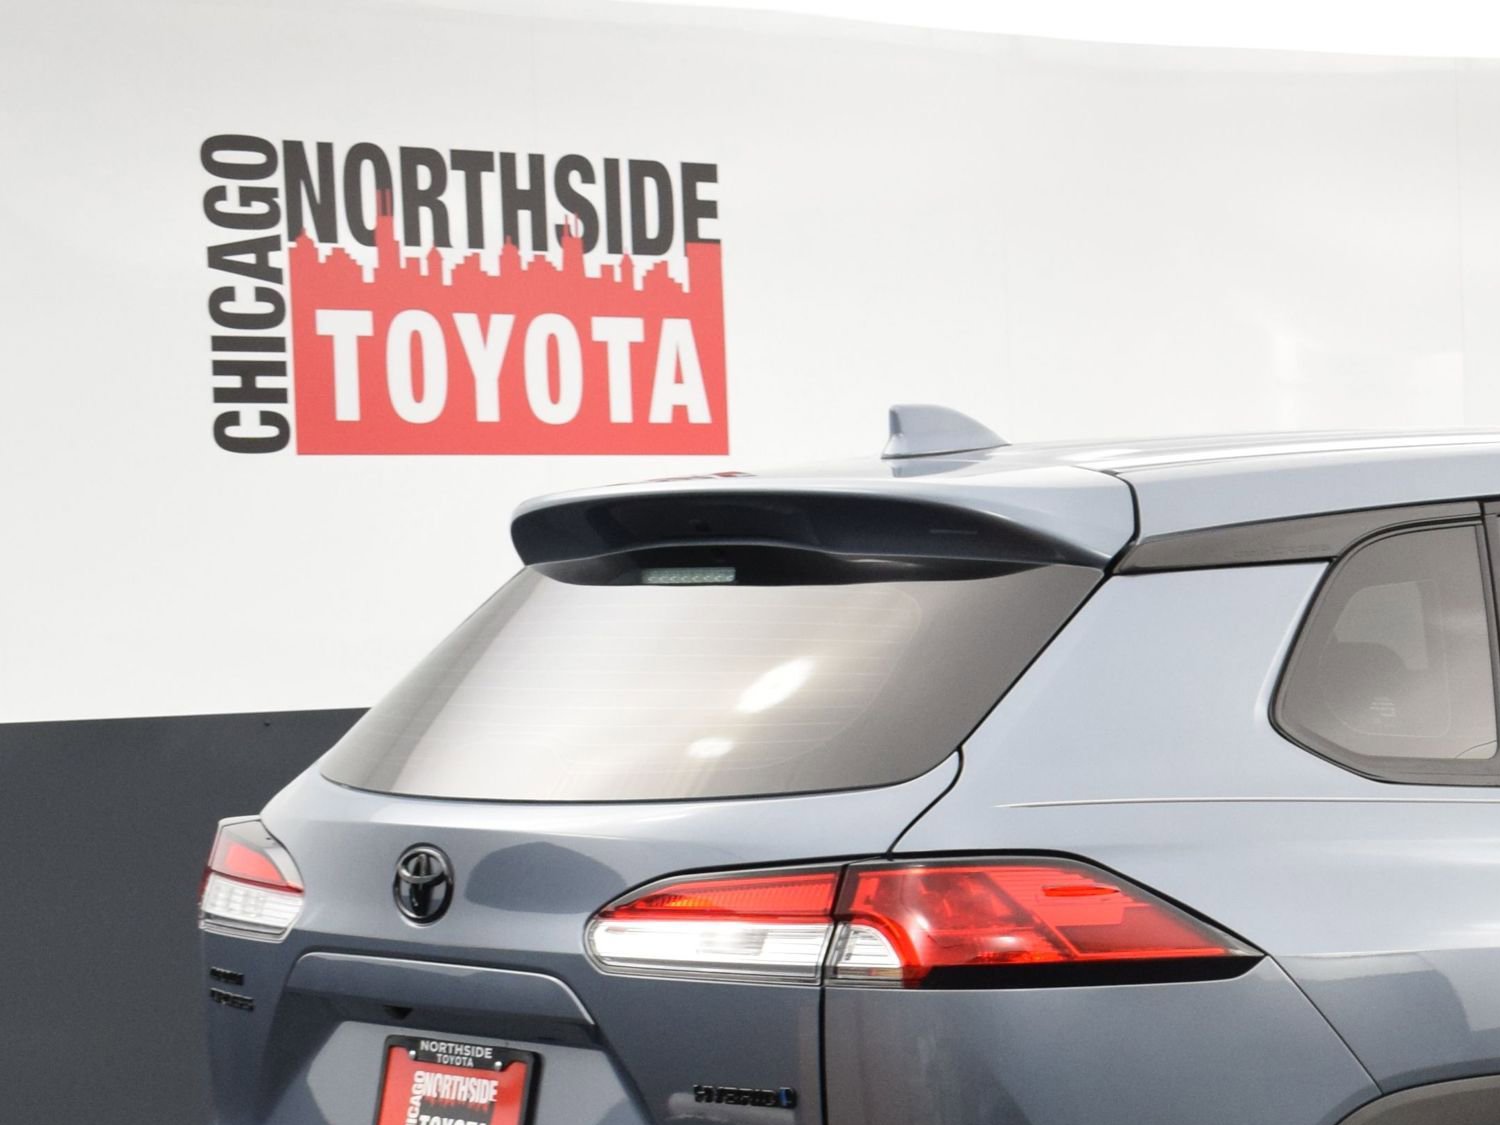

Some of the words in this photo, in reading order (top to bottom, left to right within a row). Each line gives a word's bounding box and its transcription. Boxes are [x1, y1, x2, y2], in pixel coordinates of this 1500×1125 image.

[282, 138, 722, 258] NORTHSIDE
[199, 133, 290, 455] CHICAGO
[314, 308, 713, 425] TOYOTA
[420, 1040, 493, 1059] NORTHSIDE
[436, 1053, 474, 1067] TOYOTA
[424, 1071, 499, 1104] NORTHSIDE
